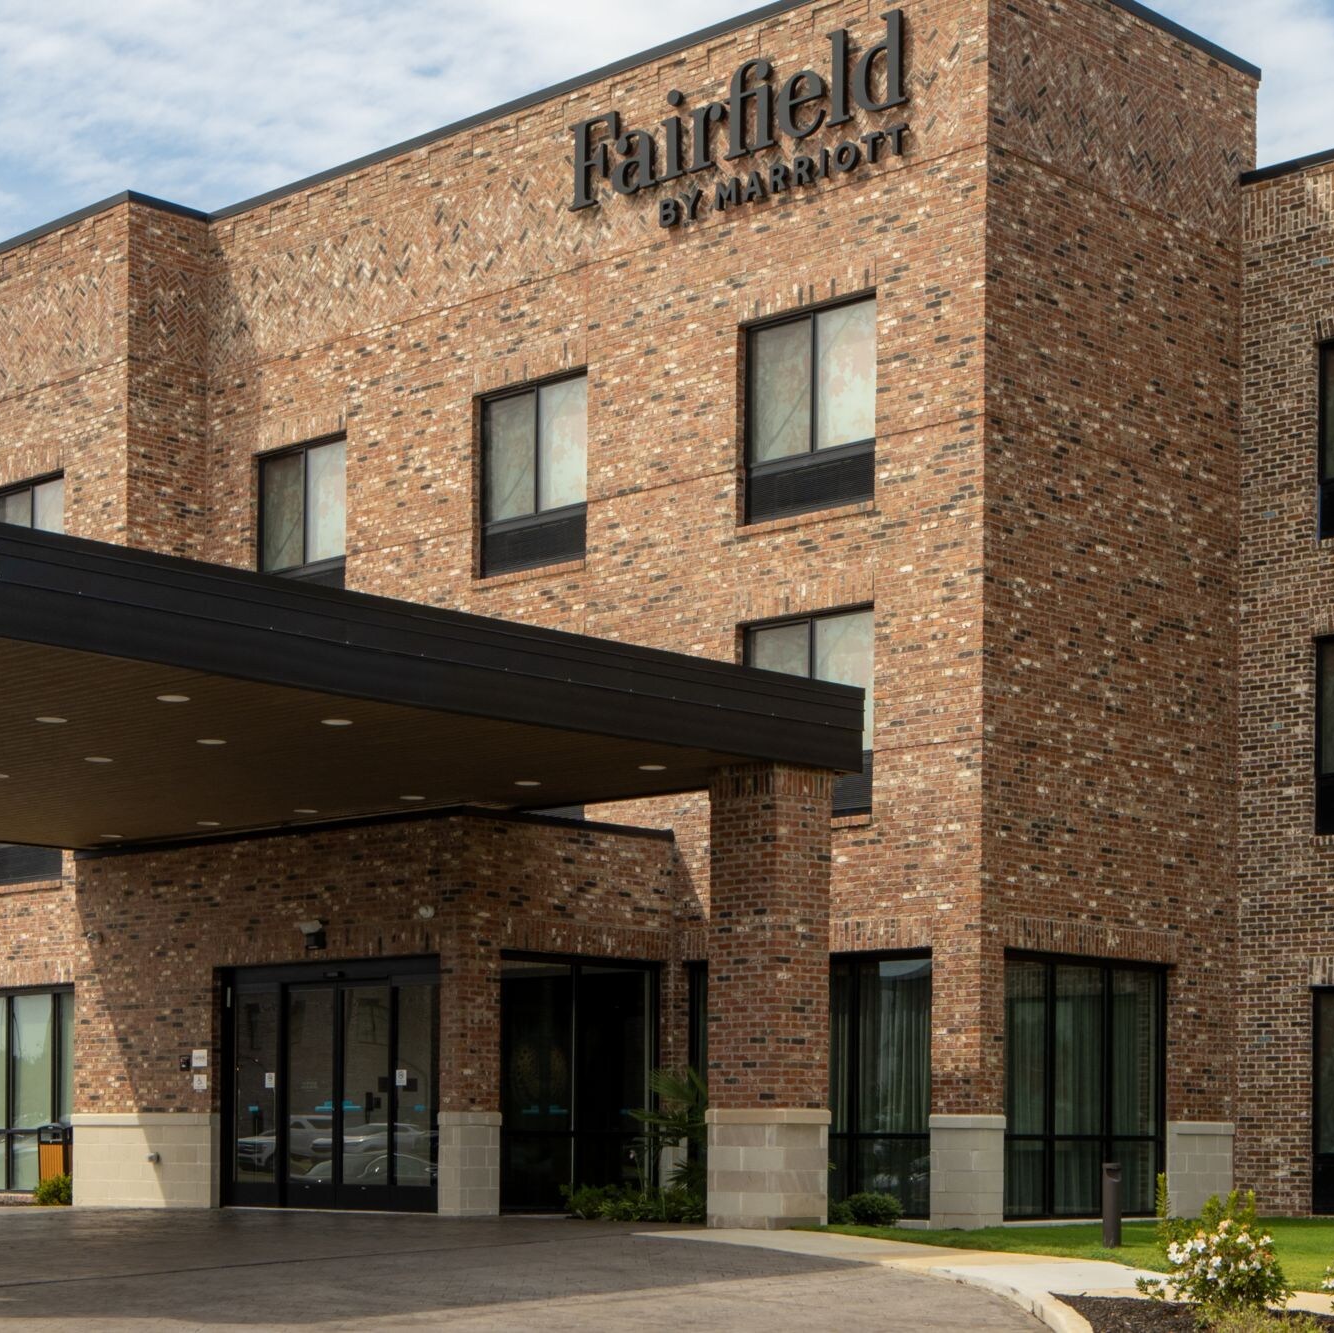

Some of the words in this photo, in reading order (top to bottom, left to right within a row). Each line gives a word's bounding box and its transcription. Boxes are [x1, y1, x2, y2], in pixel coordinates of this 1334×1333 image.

[568, 8, 910, 212] Fairfield
[659, 188, 704, 228] BY
[714, 122, 910, 212] MARRIOTT
